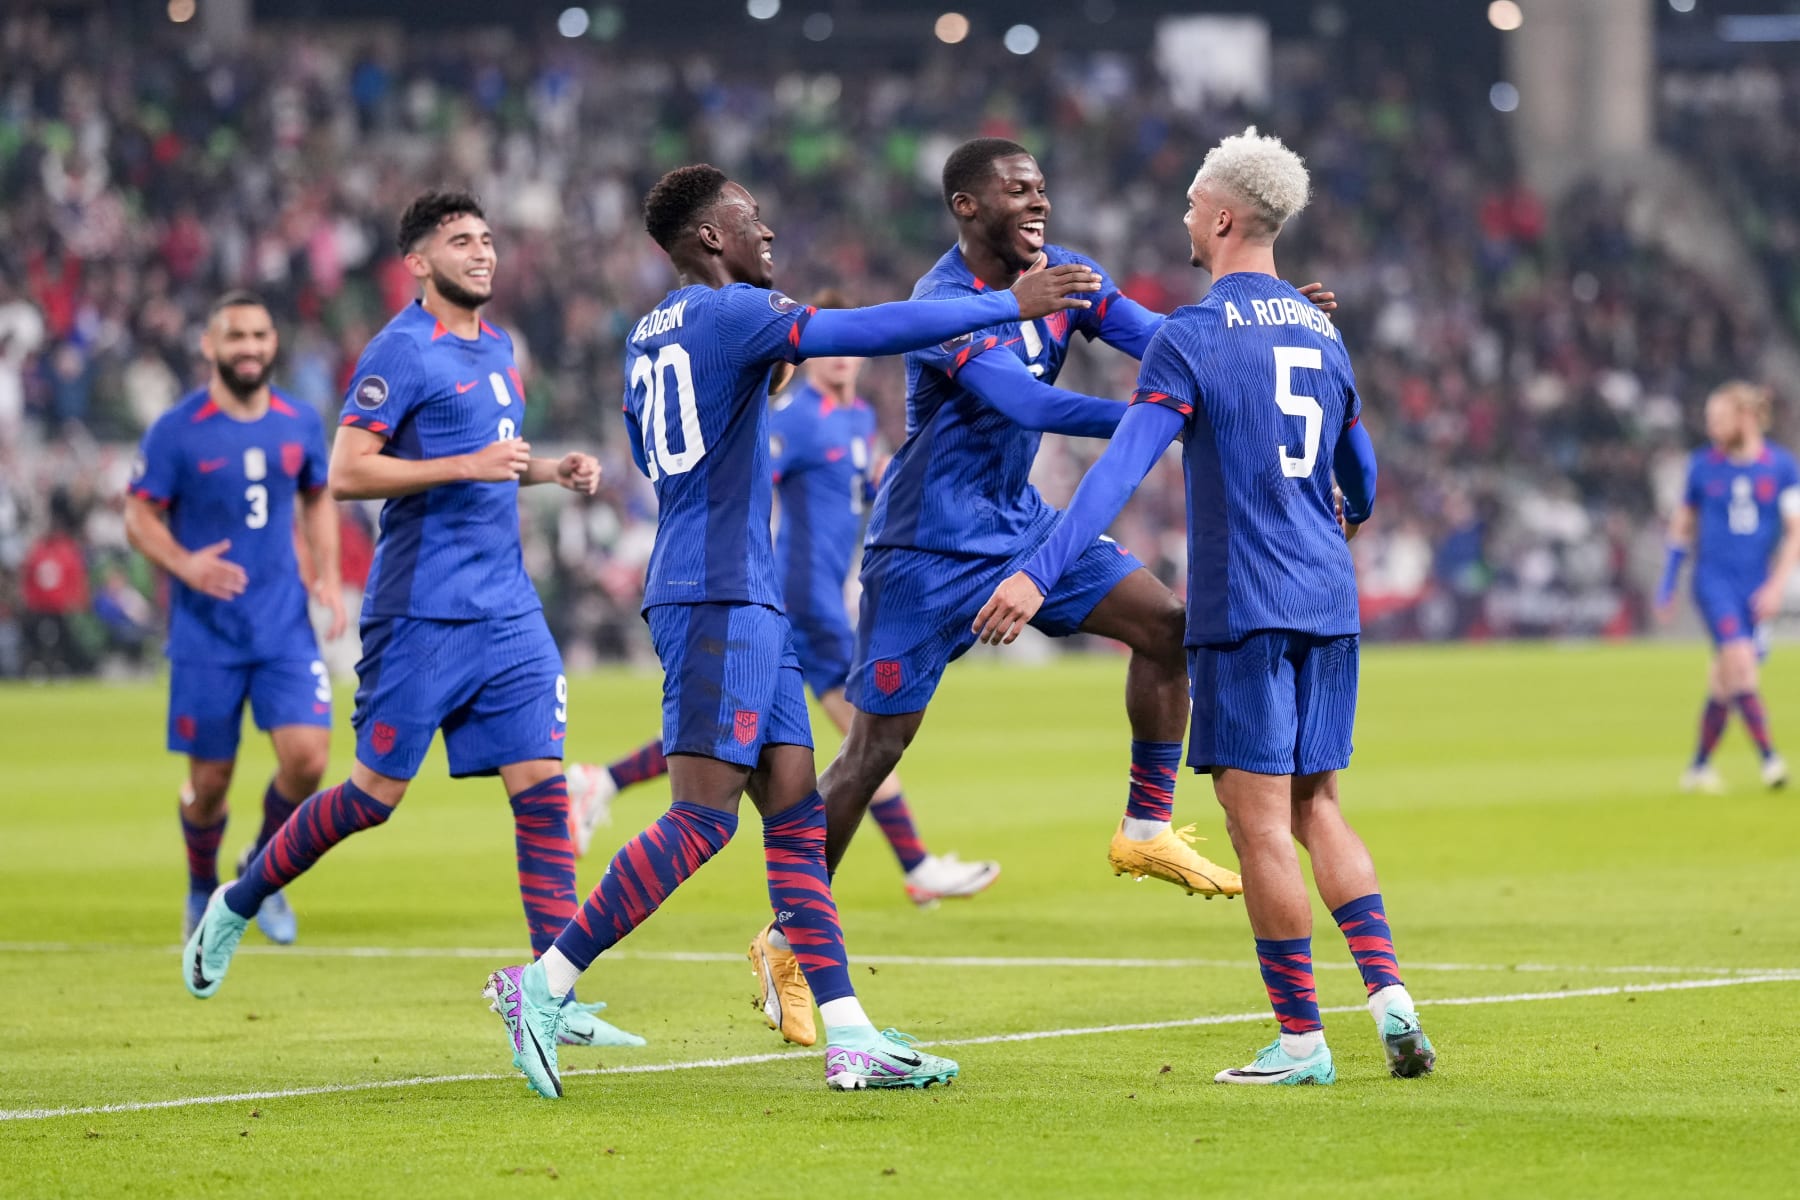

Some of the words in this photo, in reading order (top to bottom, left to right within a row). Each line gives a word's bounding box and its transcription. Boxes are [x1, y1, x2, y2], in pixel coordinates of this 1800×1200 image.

[1225, 301, 1252, 328] A.
[1252, 298, 1337, 341] ROBINSON
[631, 343, 706, 483] 20
[1273, 346, 1323, 478] 5
[244, 484, 268, 529] 3
[311, 660, 331, 703] 3
[555, 674, 567, 723] 9
